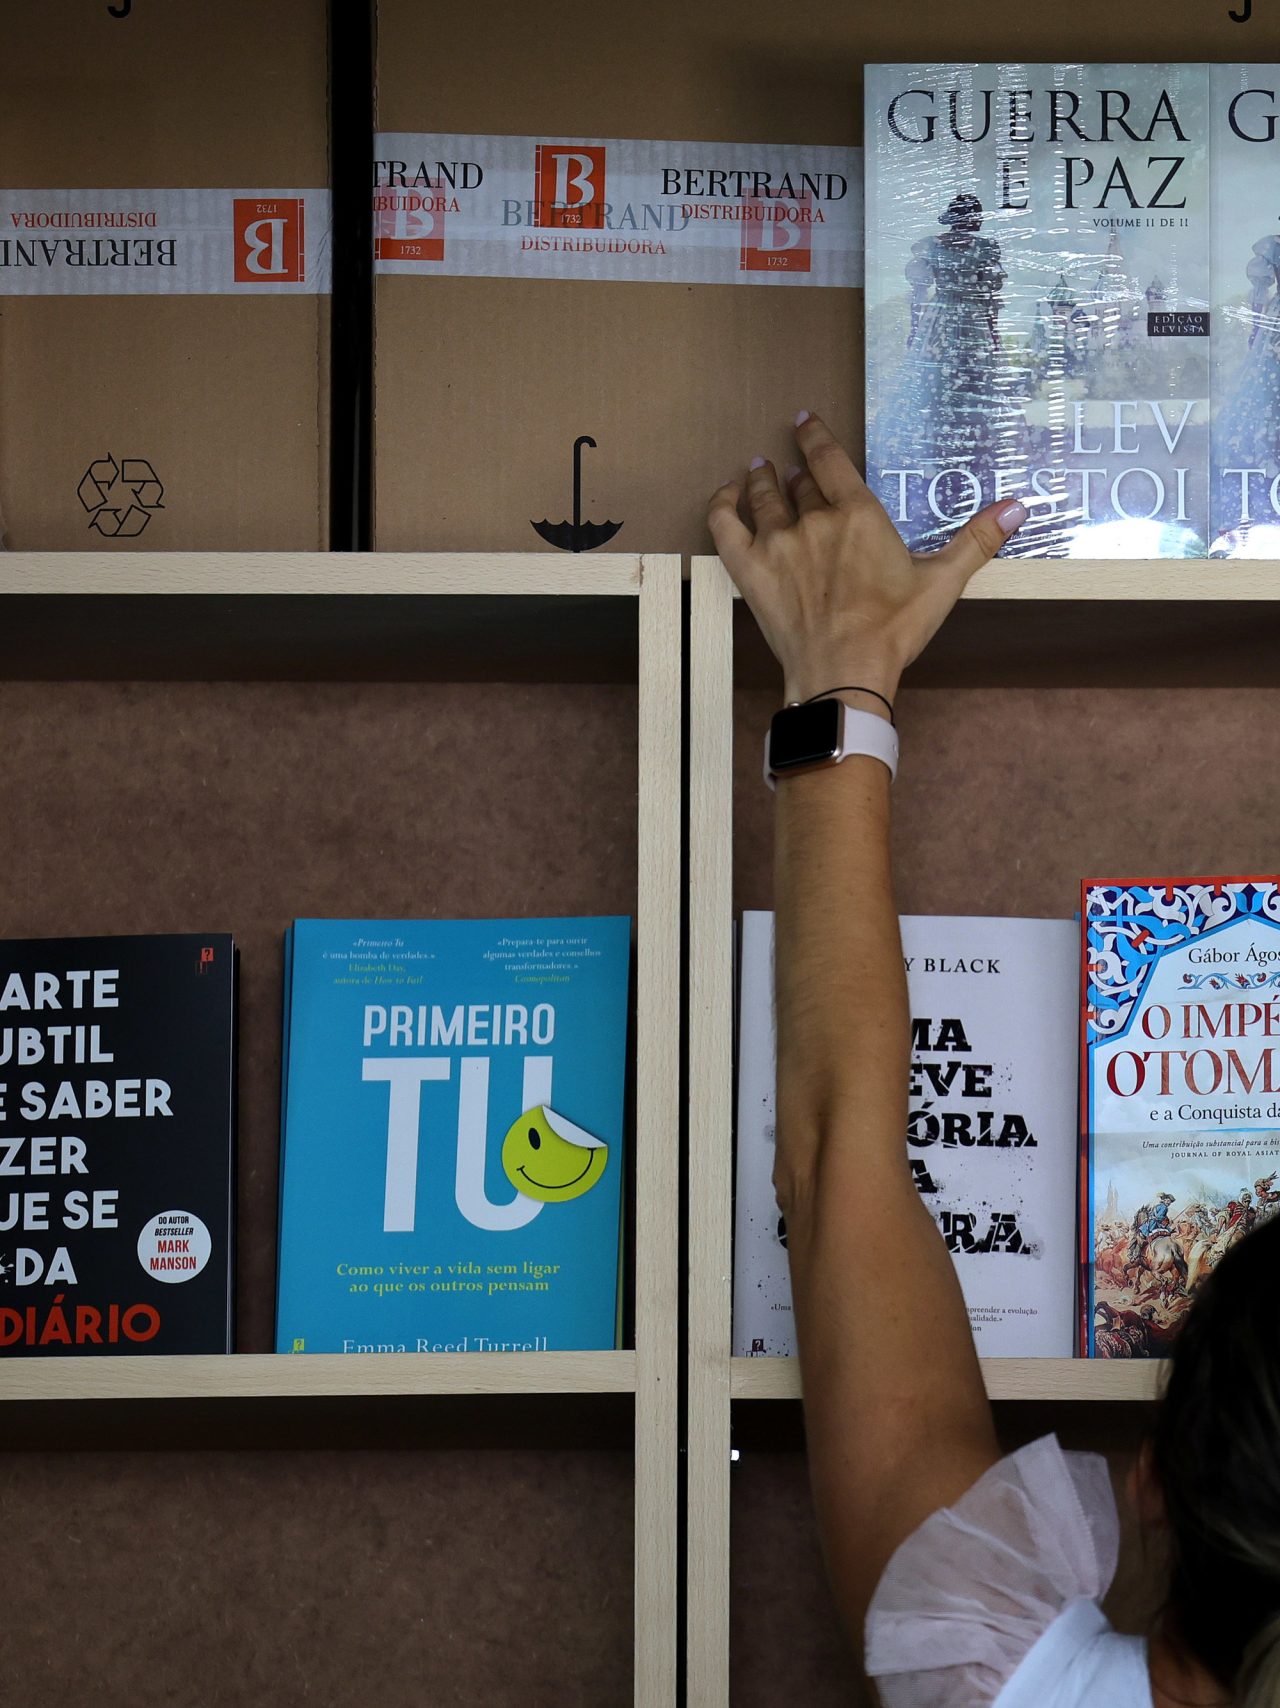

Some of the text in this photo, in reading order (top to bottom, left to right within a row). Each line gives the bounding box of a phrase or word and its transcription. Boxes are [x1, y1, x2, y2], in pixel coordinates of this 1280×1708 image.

[886, 88, 1191, 144] GUERRA
[661, 168, 848, 201] BERTRAND
[1061, 155, 1187, 209] PAZ
[256, 204, 278, 214] 1732
[681, 204, 825, 222] DISTRIBUIDORA
[10, 212, 157, 227] DISTRIBUIDORA
[560, 214, 582, 224] 1732
[1093, 218, 1141, 228] VOLUME
[1160, 218, 1175, 227] DE
[0, 239, 177, 267] BERTRAN
[400, 246, 421, 255] 1732
[521, 235, 666, 255] DISTRIBUIDORA
[767, 257, 788, 266] 1732
[1153, 325, 1205, 334] REVISTA
[1070, 399, 1199, 455] LEV
[1188, 946, 1240, 964] Gábor
[924, 958, 1001, 974] BLACK
[0, 969, 119, 1011] ARTE
[362, 1003, 556, 1047] PRIMEIRO
[1141, 1004, 1172, 1040] O
[20, 1078, 174, 1121] SABER
[1149, 1110, 1159, 1121] e
[1164, 1110, 1173, 1121] a
[1178, 1104, 1262, 1124] Conquista
[361, 1056, 553, 1233] TU
[1142, 1141, 1159, 1149] Uma
[1161, 1140, 1204, 1149] contribuição
[1205, 1138, 1244, 1147] substancial
[1245, 1139, 1262, 1148] para
[62, 1190, 119, 1230] SE
[158, 1216, 189, 1225] DO AUTOR
[154, 1227, 194, 1236] BESTSELLER
[157, 1240, 190, 1253] MARK
[150, 1257, 197, 1270] MANSON
[336, 1261, 561, 1279] Como viver a vida sem ligar
[349, 1280, 550, 1296] ao que os outros pensam
[0, 1294, 161, 1346] DIÁRIO
[1008, 1306, 1038, 1316] evolução
[343, 1336, 548, 1353] Emma Reed Turrell
